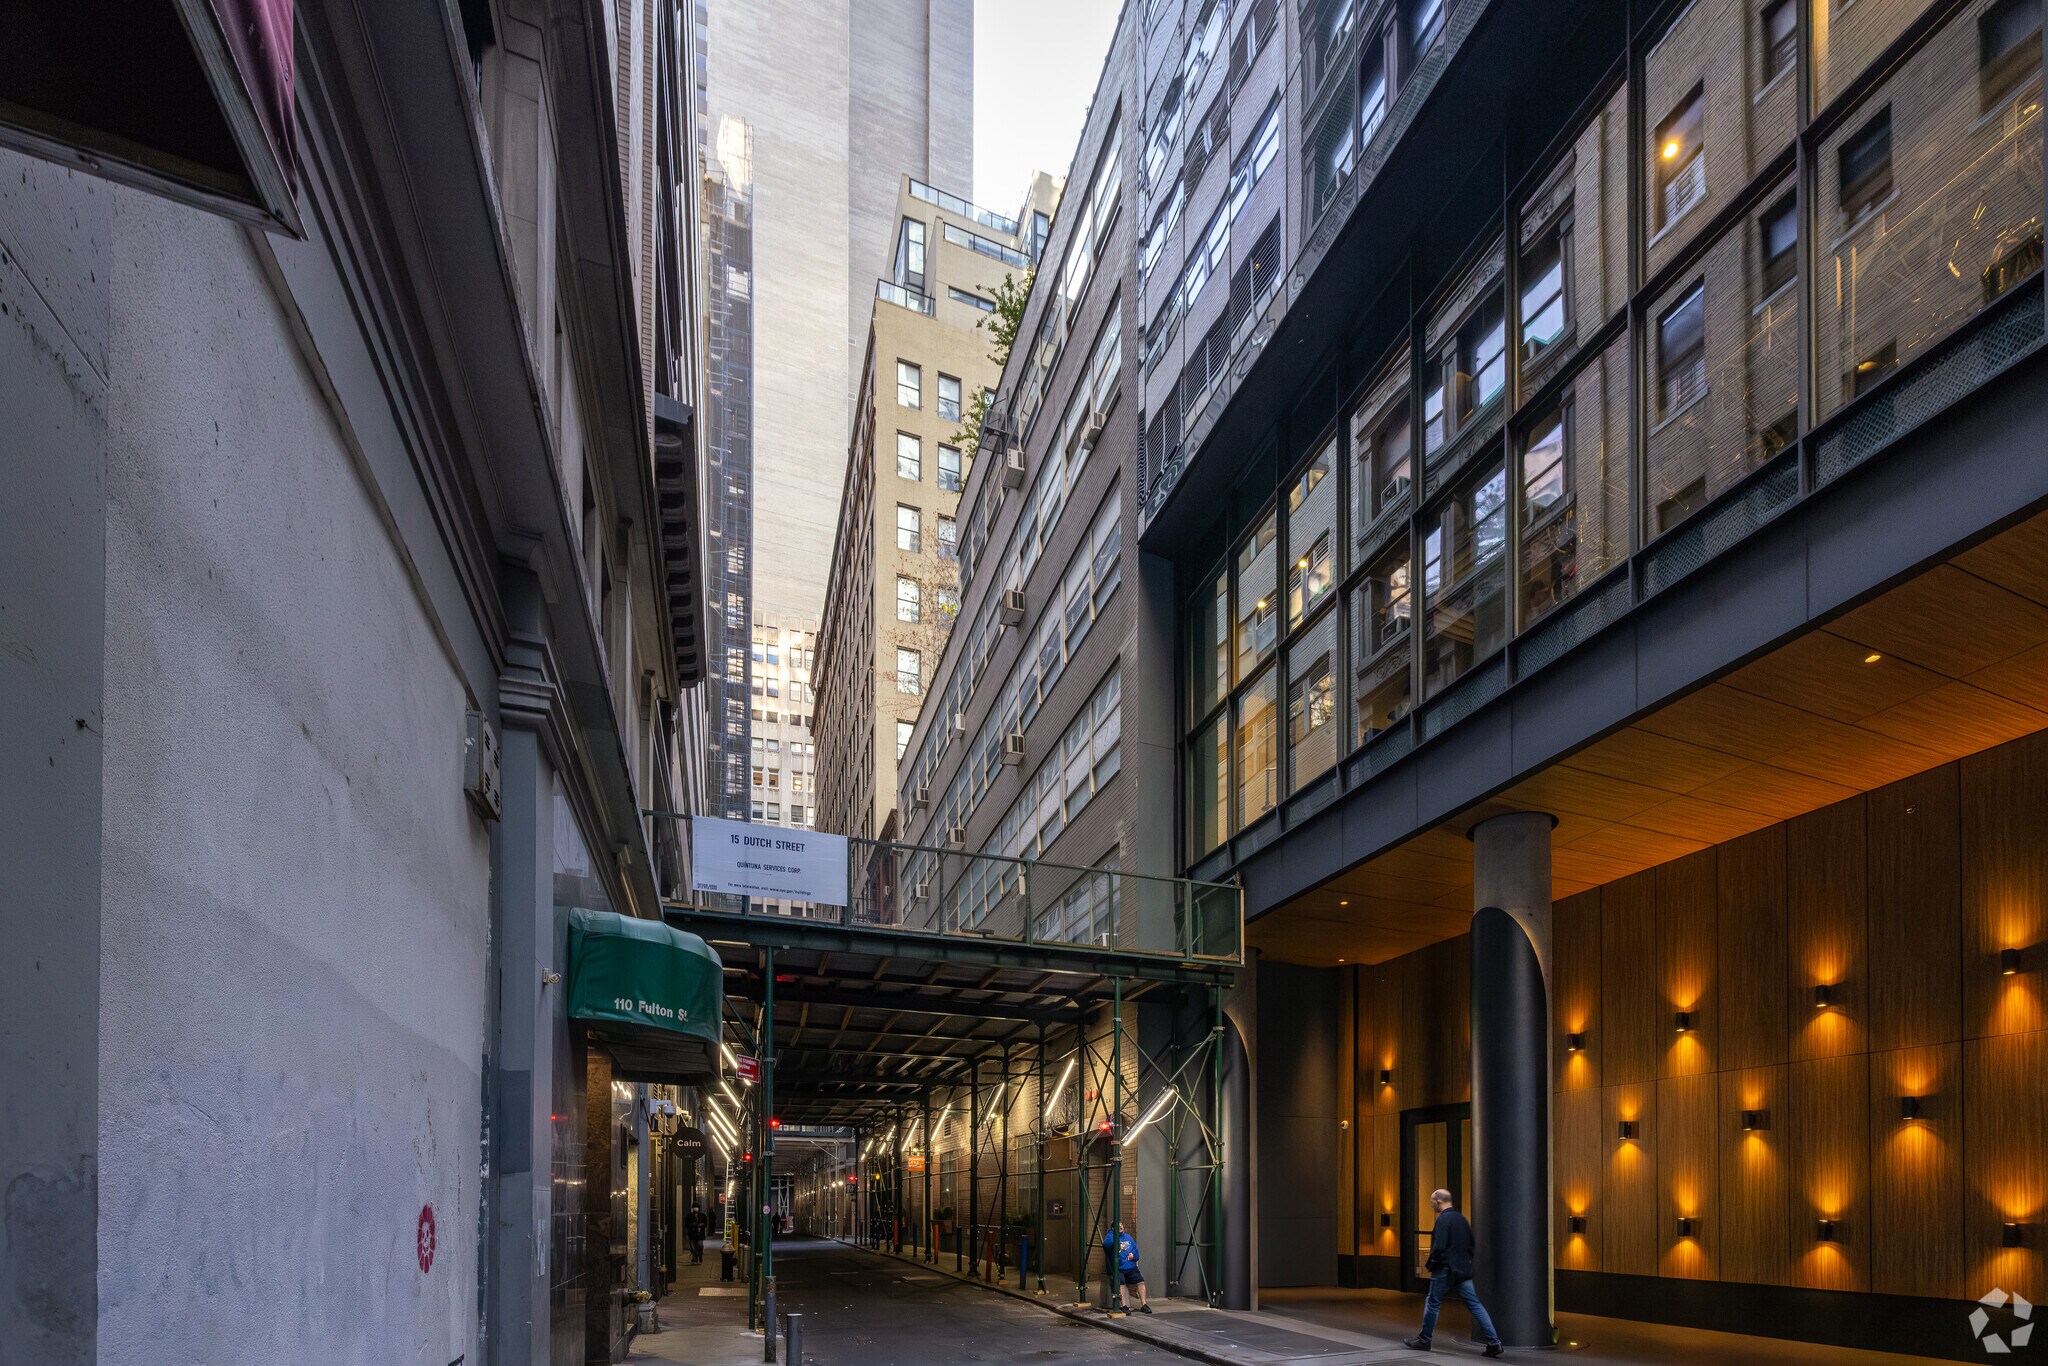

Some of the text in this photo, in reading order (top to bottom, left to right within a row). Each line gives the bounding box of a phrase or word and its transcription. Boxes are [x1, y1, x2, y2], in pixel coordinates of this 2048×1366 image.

[731, 834, 805, 852] 15 DUTCH STREET
[763, 864, 786, 873] SERVICES
[614, 997, 633, 1011] 110
[638, 1000, 673, 1018] Fulton
[677, 1139, 701, 1147] Calm
